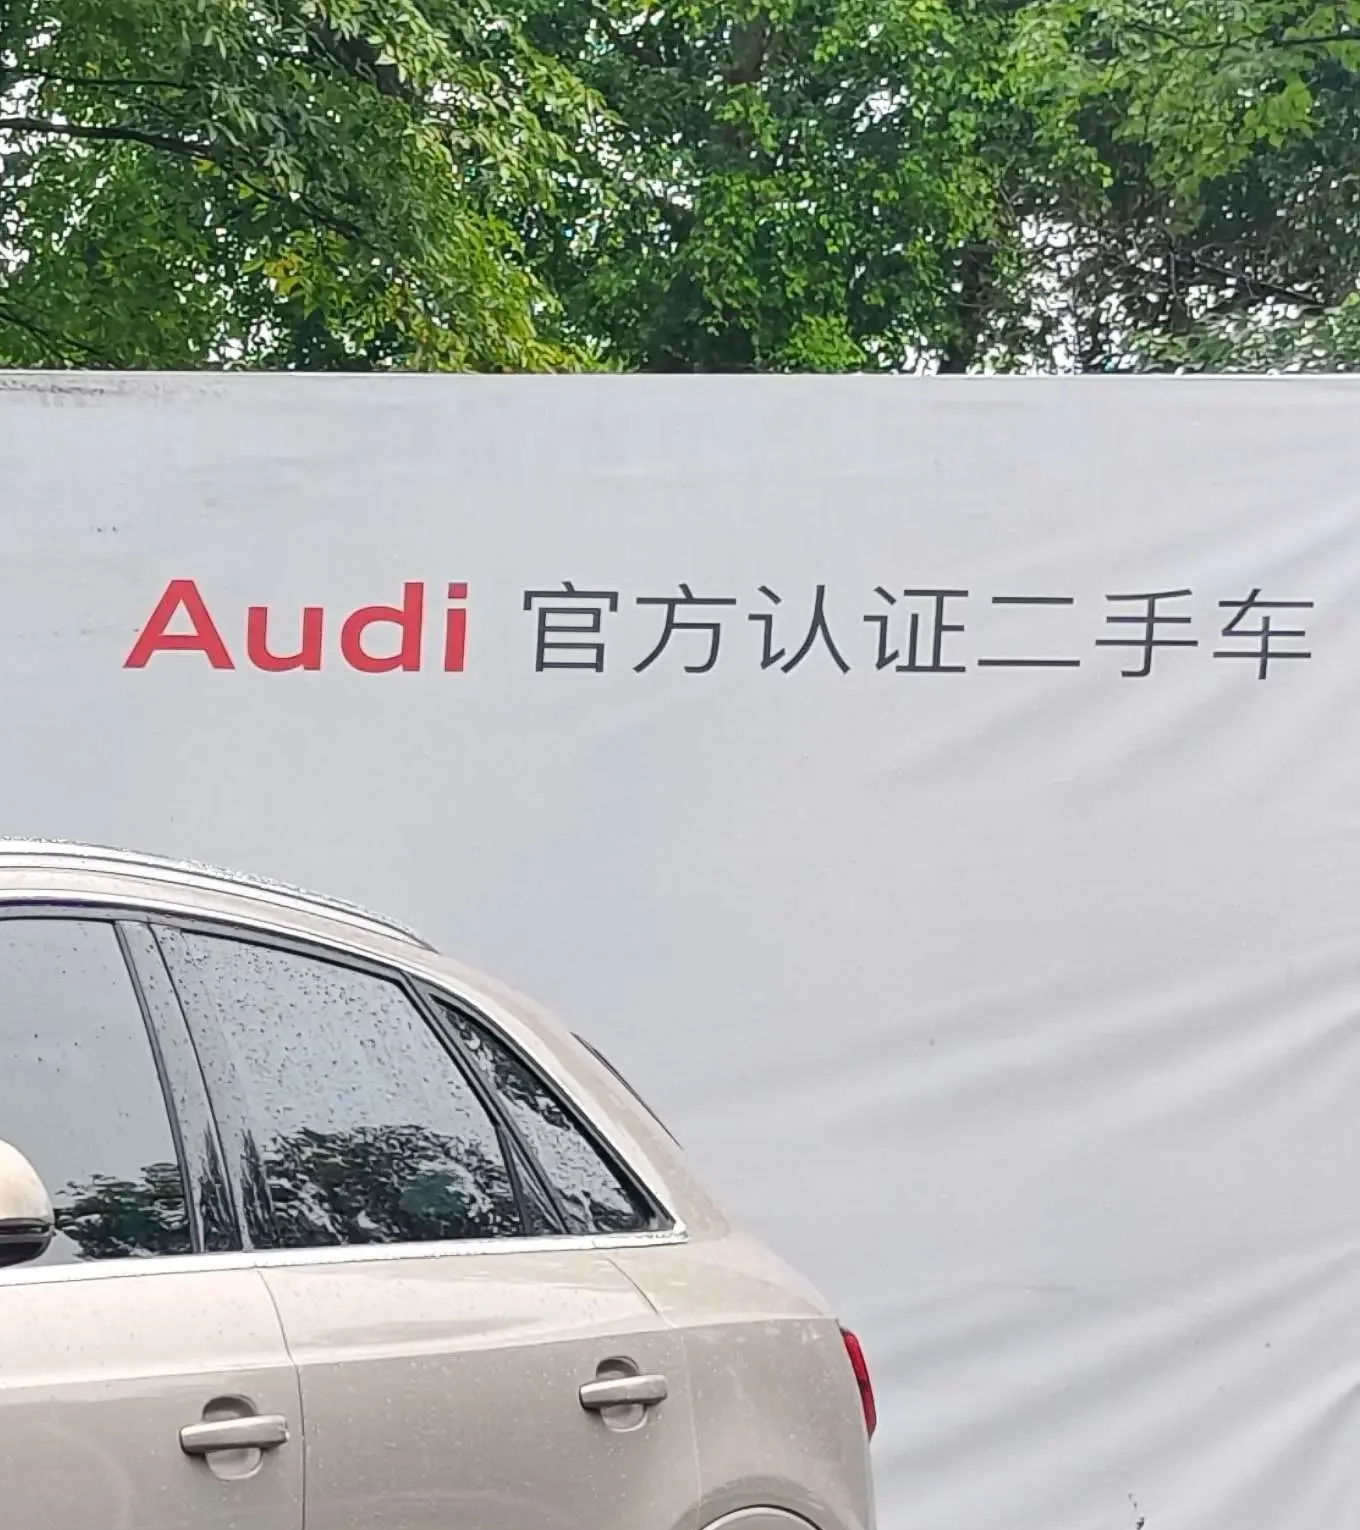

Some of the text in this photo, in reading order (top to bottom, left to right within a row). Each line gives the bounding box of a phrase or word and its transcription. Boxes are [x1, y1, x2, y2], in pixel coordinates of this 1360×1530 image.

[123, 579, 1314, 681] Audi 官方认证二手车
